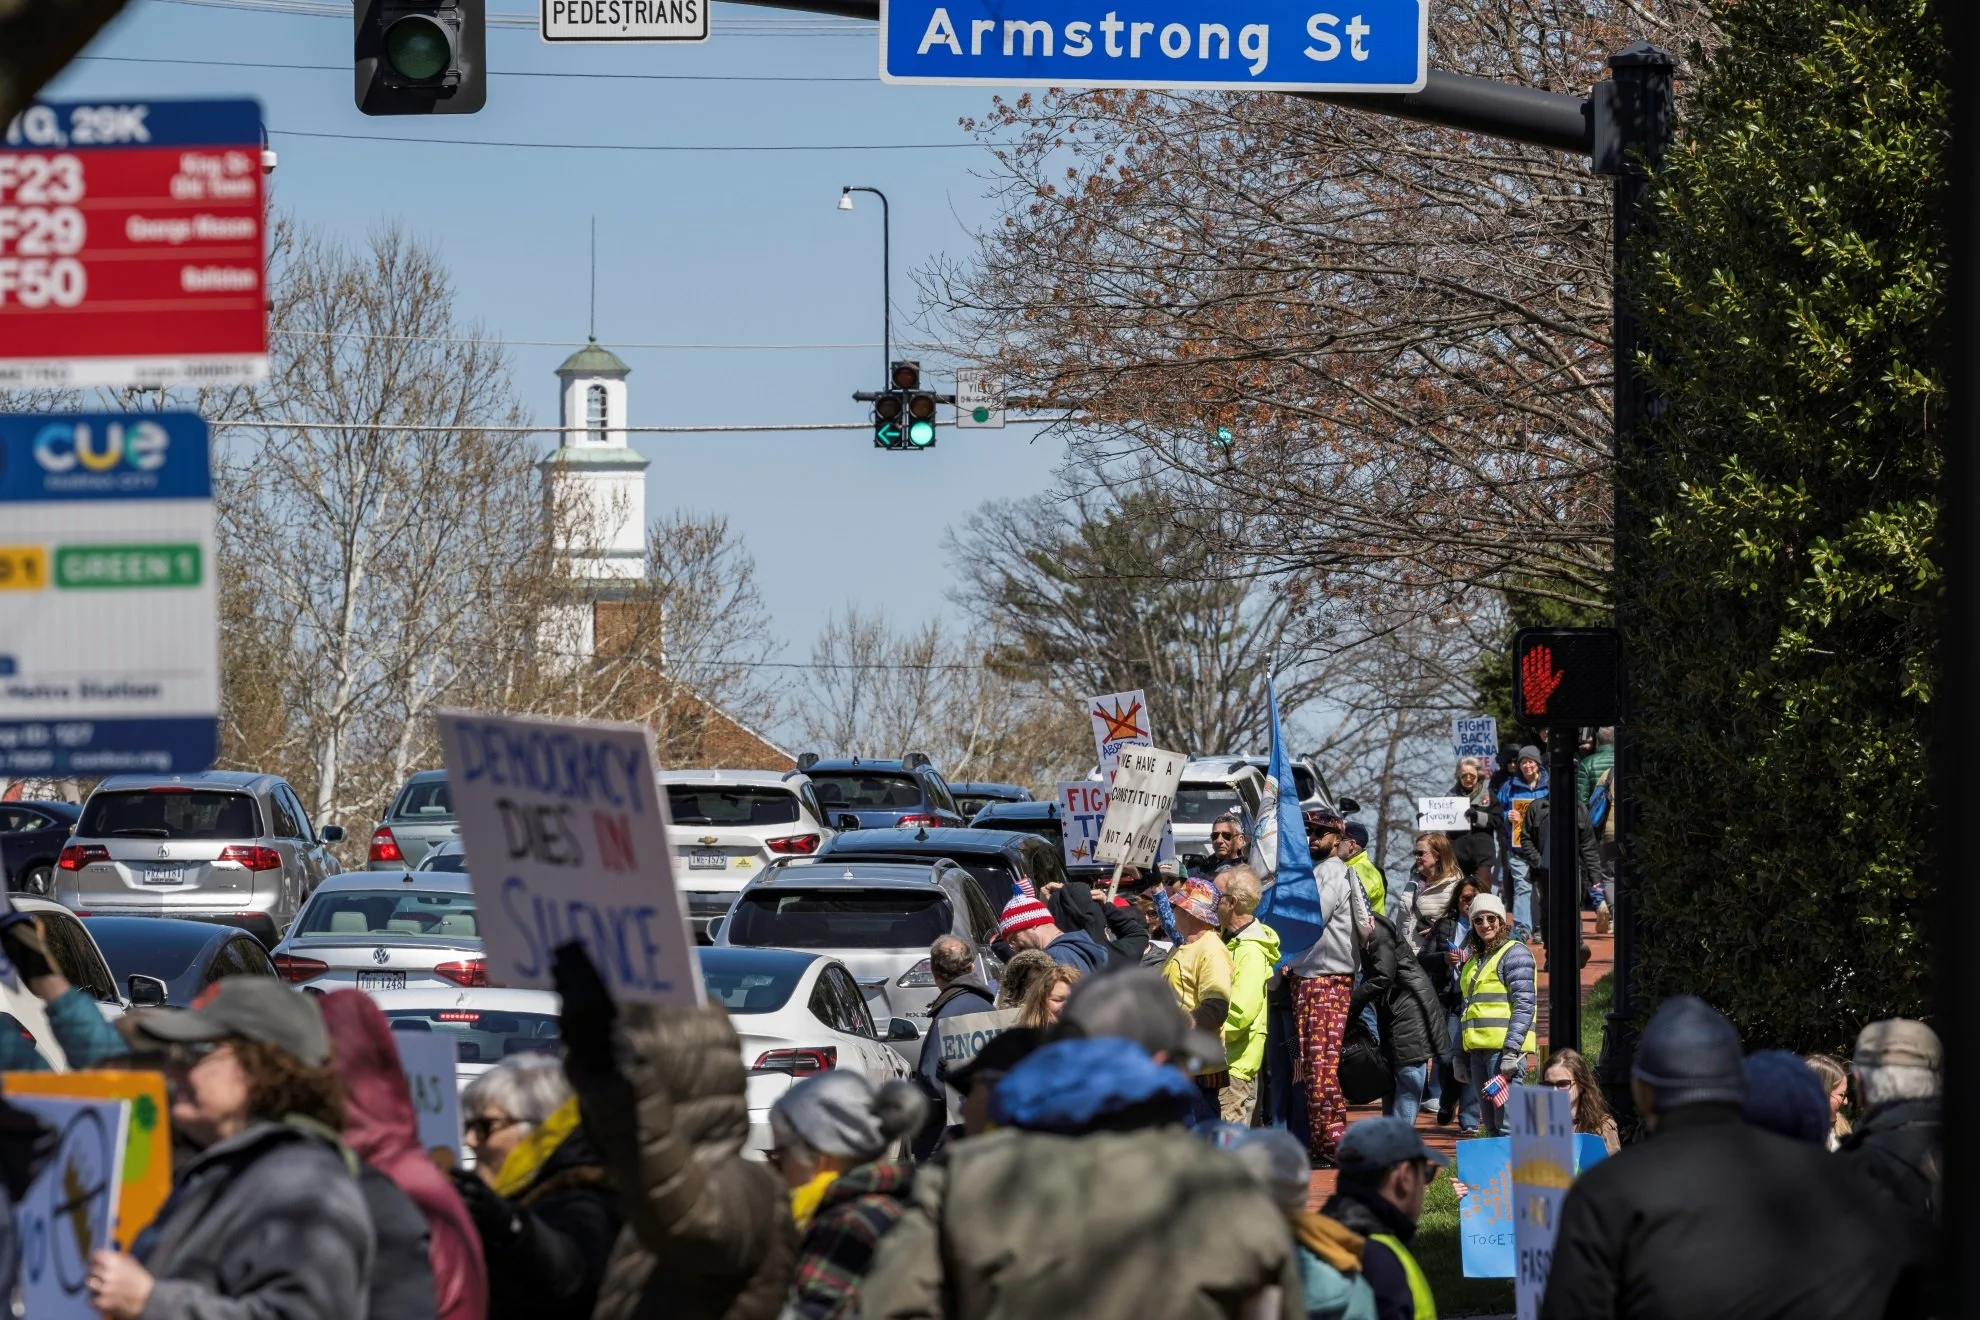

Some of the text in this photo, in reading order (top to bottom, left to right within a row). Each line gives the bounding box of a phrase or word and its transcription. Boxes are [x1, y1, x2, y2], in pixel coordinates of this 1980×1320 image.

[553, 0, 697, 25] PEDESTRIANS
[916, 7, 1370, 77] Armstrong St
[0, 153, 85, 205] F23
[0, 206, 87, 256] F29
[0, 257, 87, 308] F50
[62, 553, 170, 583] GREEN
[1457, 720, 1492, 732] FIGHT
[1460, 732, 1492, 744] BACK
[1453, 744, 1497, 757] VIRGINIA
[454, 720, 645, 815] DEMOCRACY
[1121, 753, 1132, 769] WE
[1136, 755, 1157, 773] HAVE
[1166, 761, 1172, 776] A
[1111, 786, 1173, 811] CONSTITUTION
[495, 798, 640, 876] DIES IN
[1104, 828, 1157, 853] NOT A KING
[1468, 1232, 1515, 1247] TOGET
